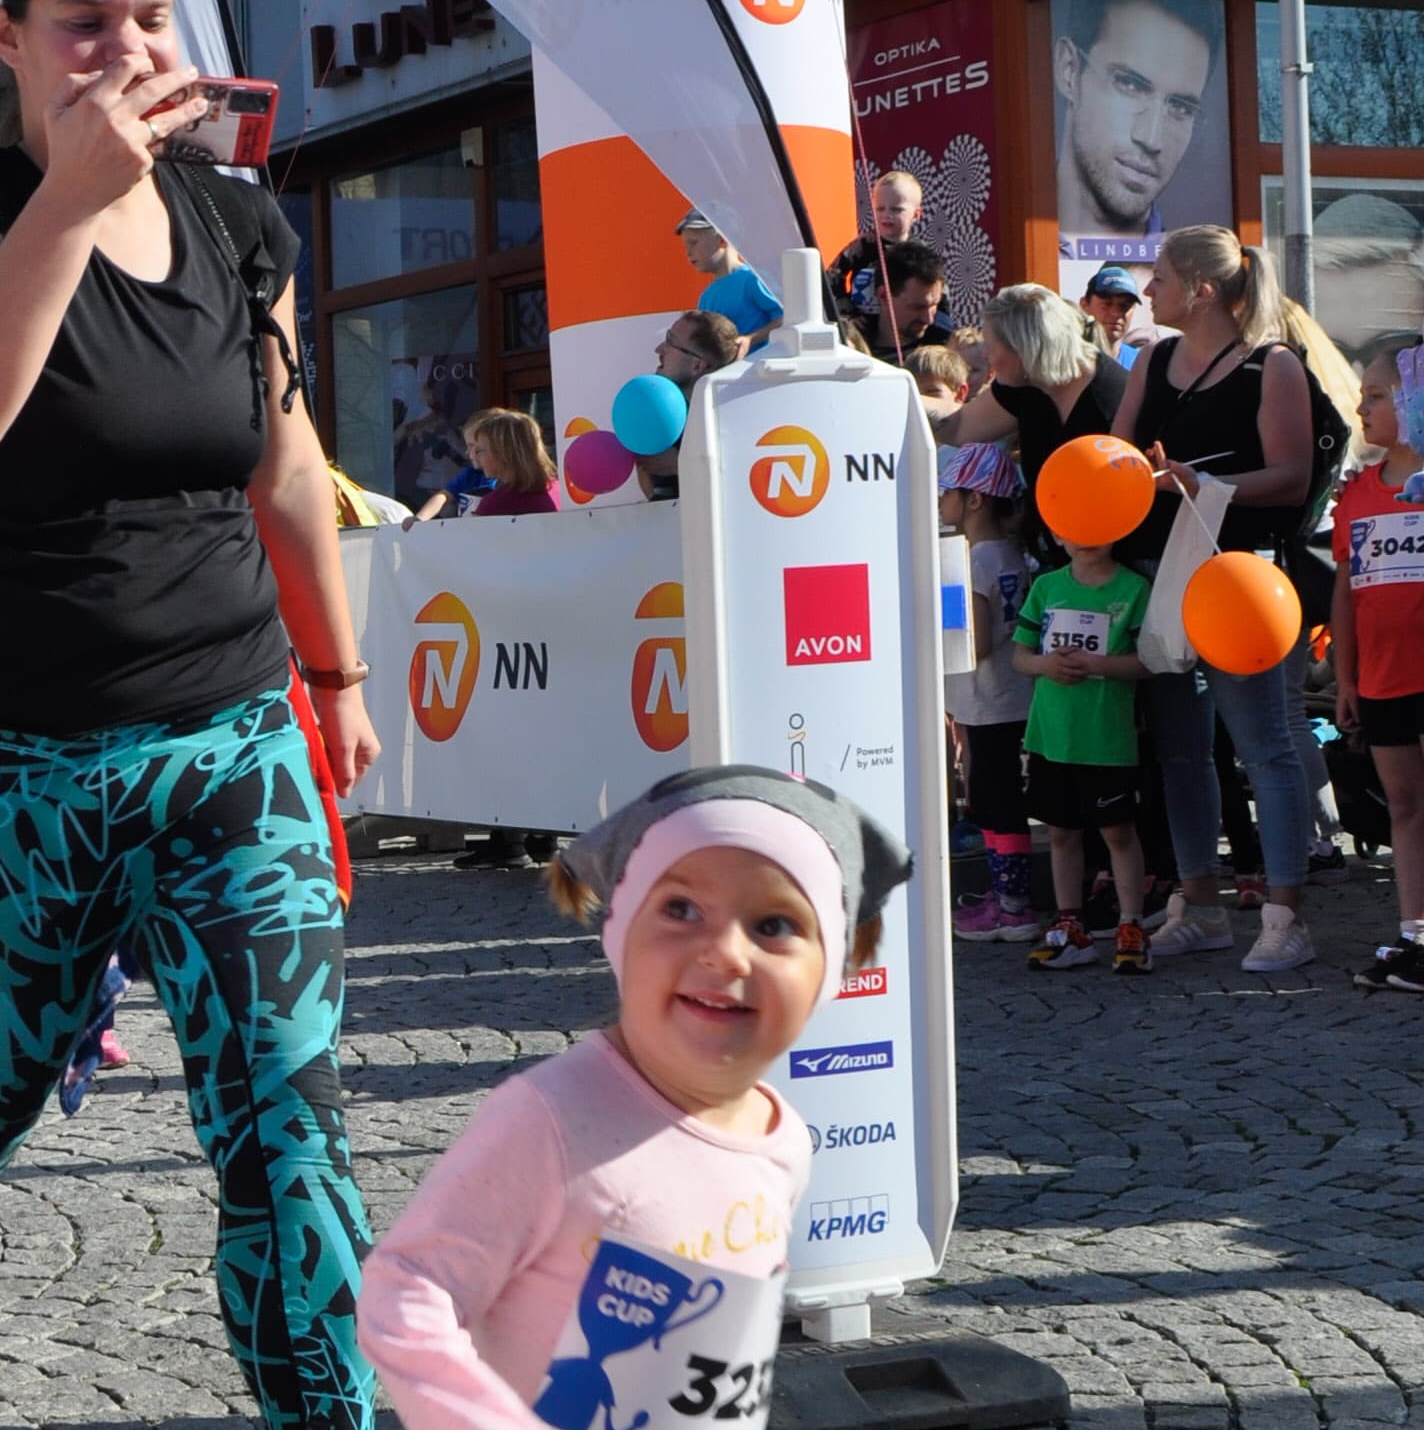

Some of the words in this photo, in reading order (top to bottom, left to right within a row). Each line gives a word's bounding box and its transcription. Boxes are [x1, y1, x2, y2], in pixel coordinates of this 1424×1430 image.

[873, 37, 941, 66] OPTIKA
[854, 59, 990, 117] UNETTES
[844, 453, 895, 482] NN
[1371, 536, 1424, 558] 3042
[795, 635, 862, 657] AVON
[1051, 632, 1099, 652] 3156
[493, 642, 548, 690] NN
[856, 744, 894, 756] Powered
[856, 759, 868, 770] by
[871, 757, 893, 767] MVM
[826, 1122, 896, 1149] ŠKODA
[808, 1210, 886, 1242] KPMG
[604, 1265, 672, 1306] KIDS
[597, 1293, 655, 1328] CUP
